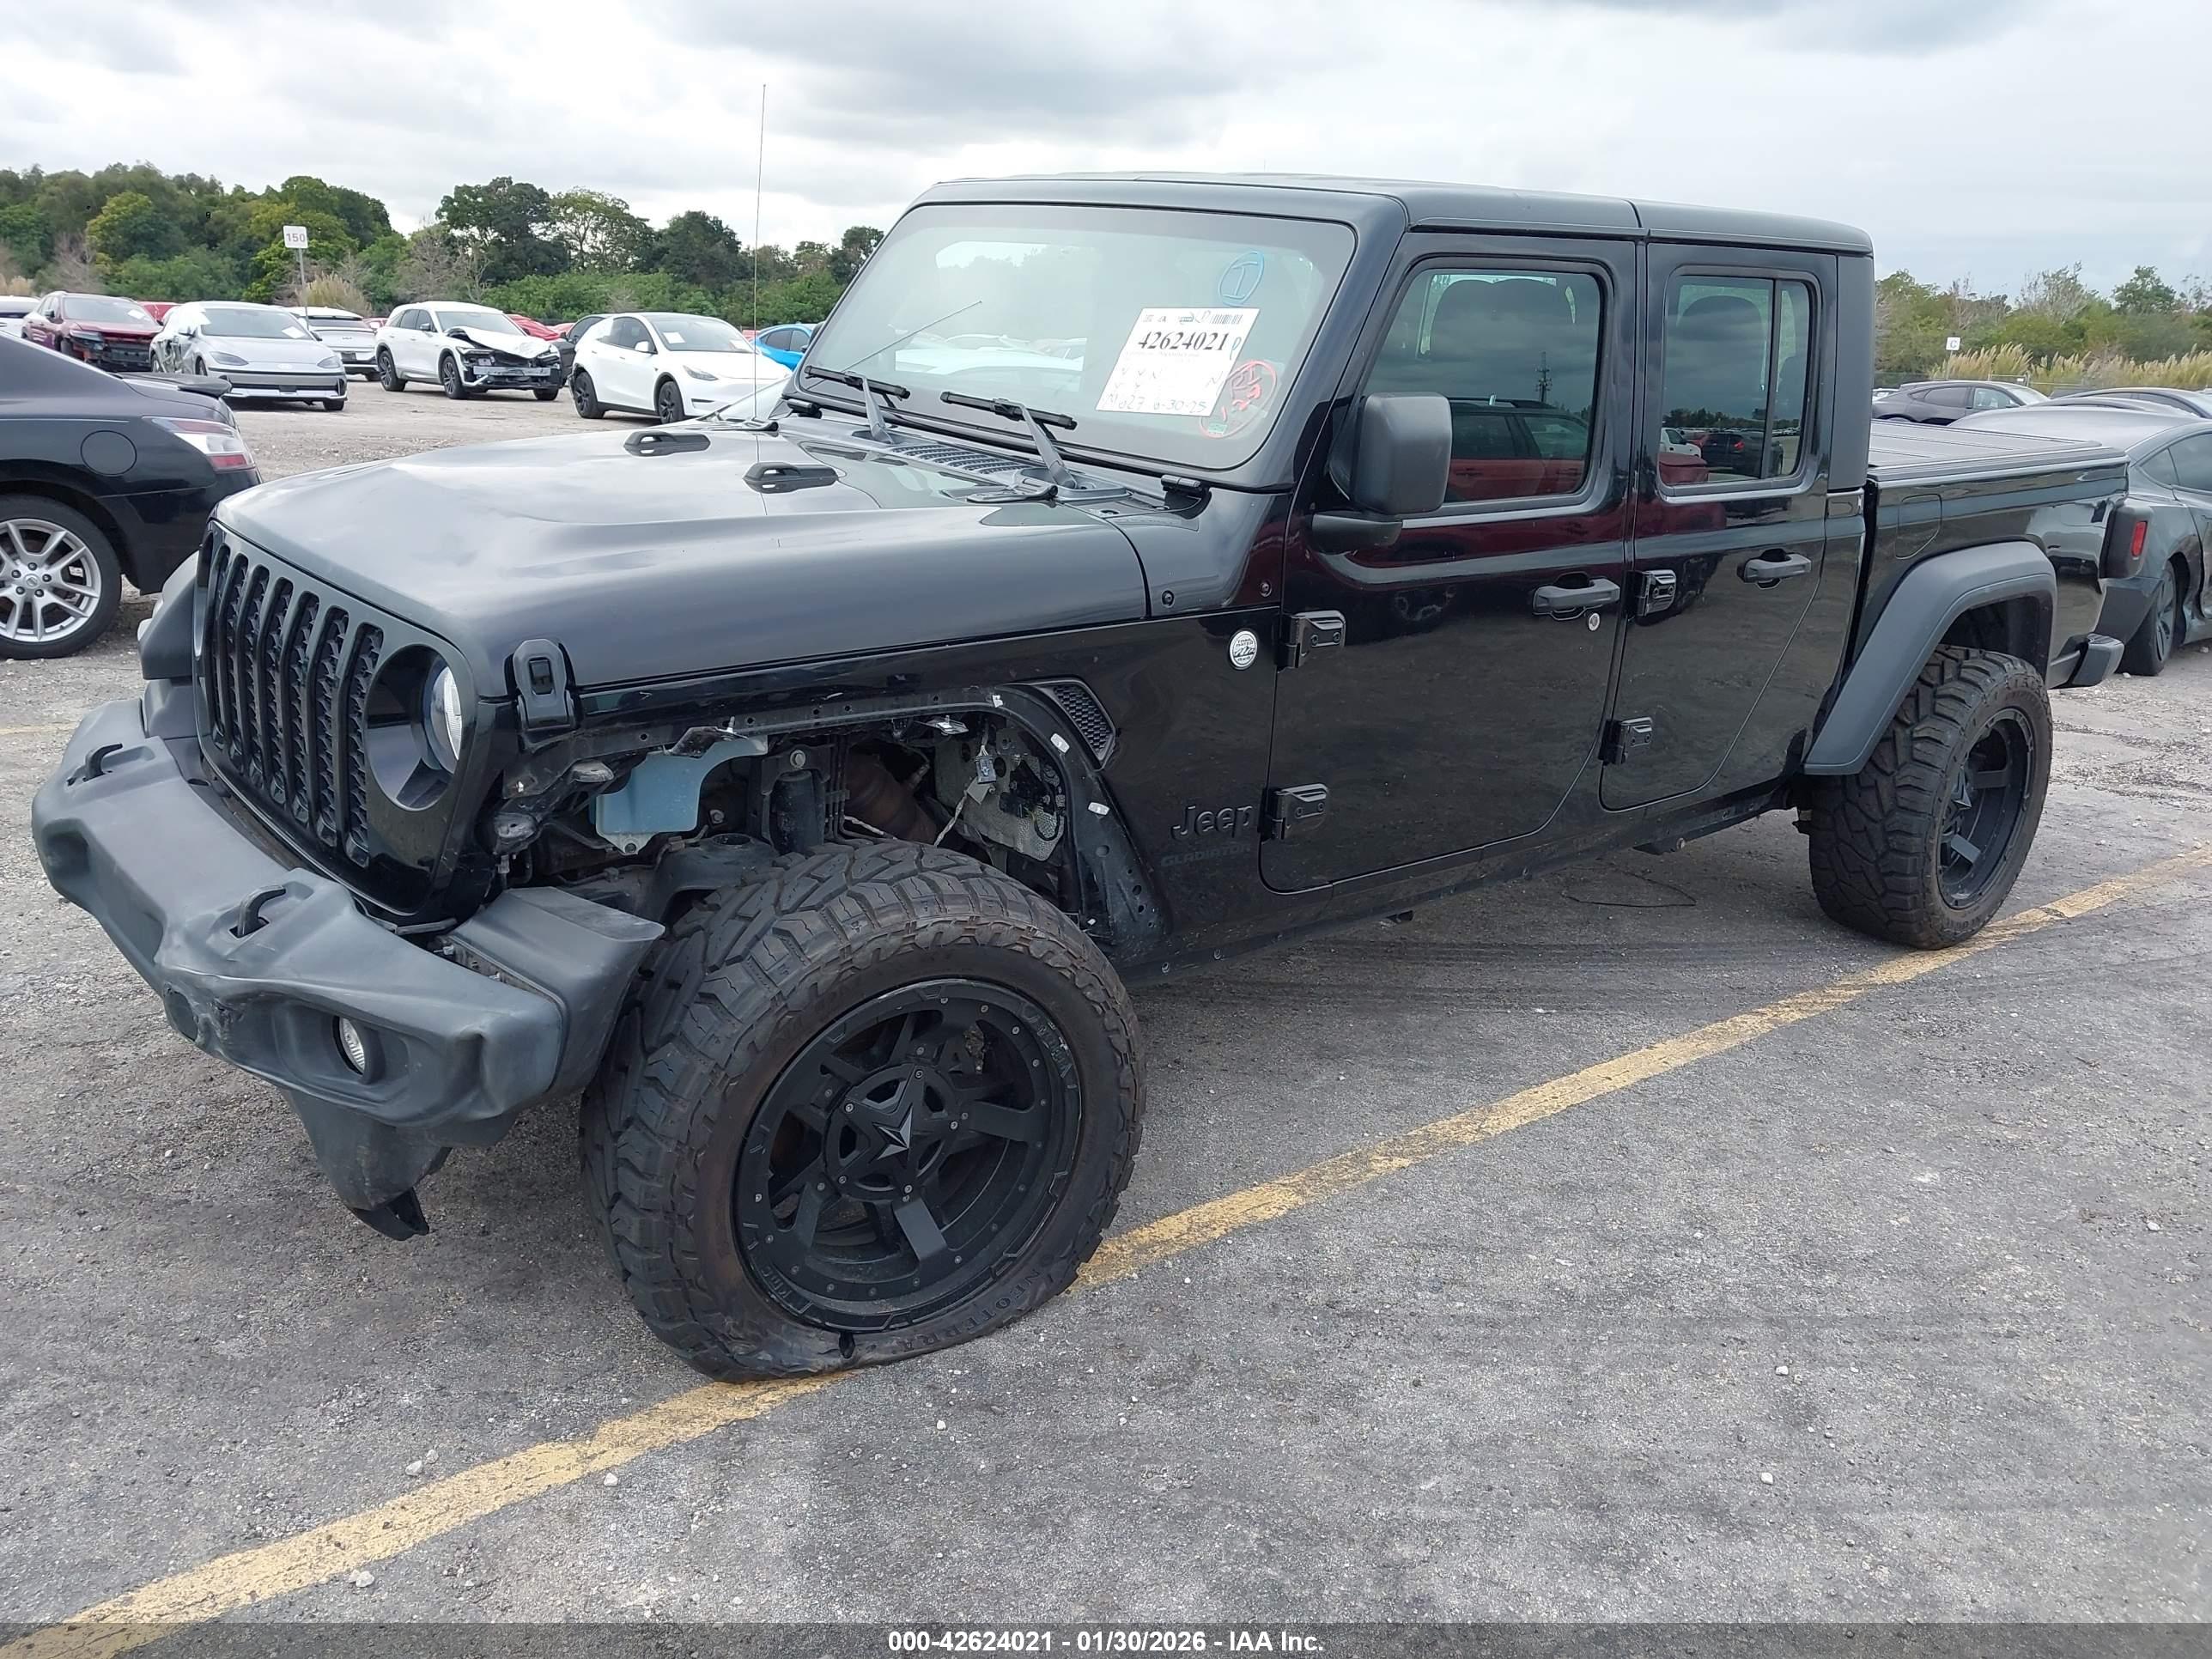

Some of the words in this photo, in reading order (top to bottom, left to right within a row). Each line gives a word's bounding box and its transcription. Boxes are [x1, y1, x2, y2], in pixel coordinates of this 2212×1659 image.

[286, 233, 306, 242] 150
[1138, 331, 1230, 351] 42624021
[1949, 339, 1958, 349] C
[1170, 805, 1254, 842] Jeep
[1160, 842, 1251, 866] GLADIATOR
